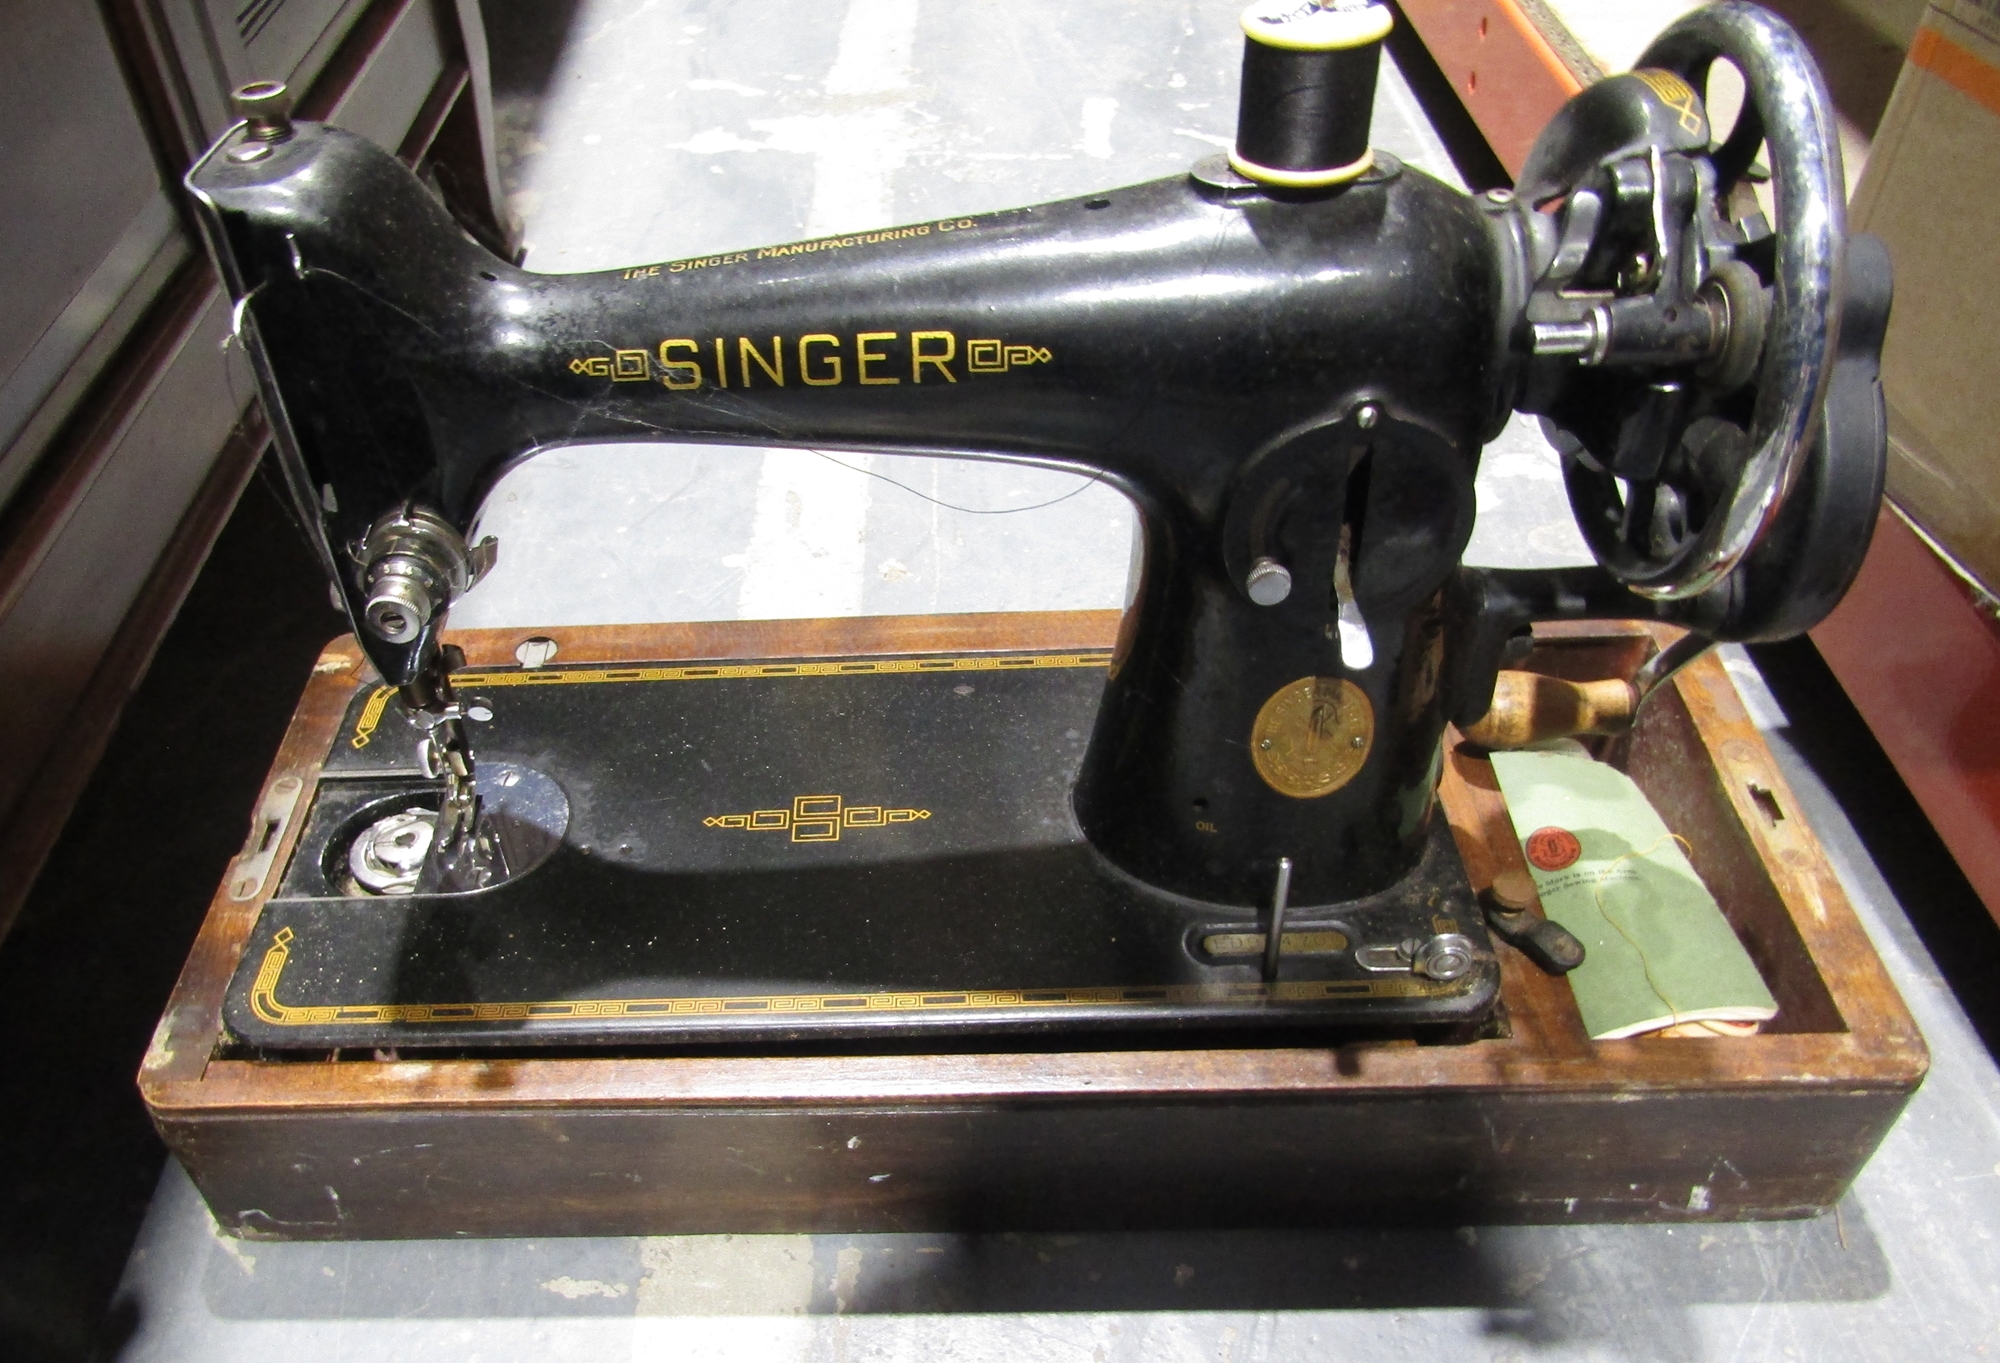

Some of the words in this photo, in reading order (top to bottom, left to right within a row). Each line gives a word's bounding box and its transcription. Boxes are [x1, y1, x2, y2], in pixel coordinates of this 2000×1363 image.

[623, 265, 661, 280] THE
[669, 252, 749, 273] SINGER
[757, 225, 931, 260] MANUFACTURING
[938, 219, 978, 232] CO.
[658, 330, 957, 391] SINGER
[383, 563, 391, 574] 5
[1195, 820, 1218, 833] OIL
